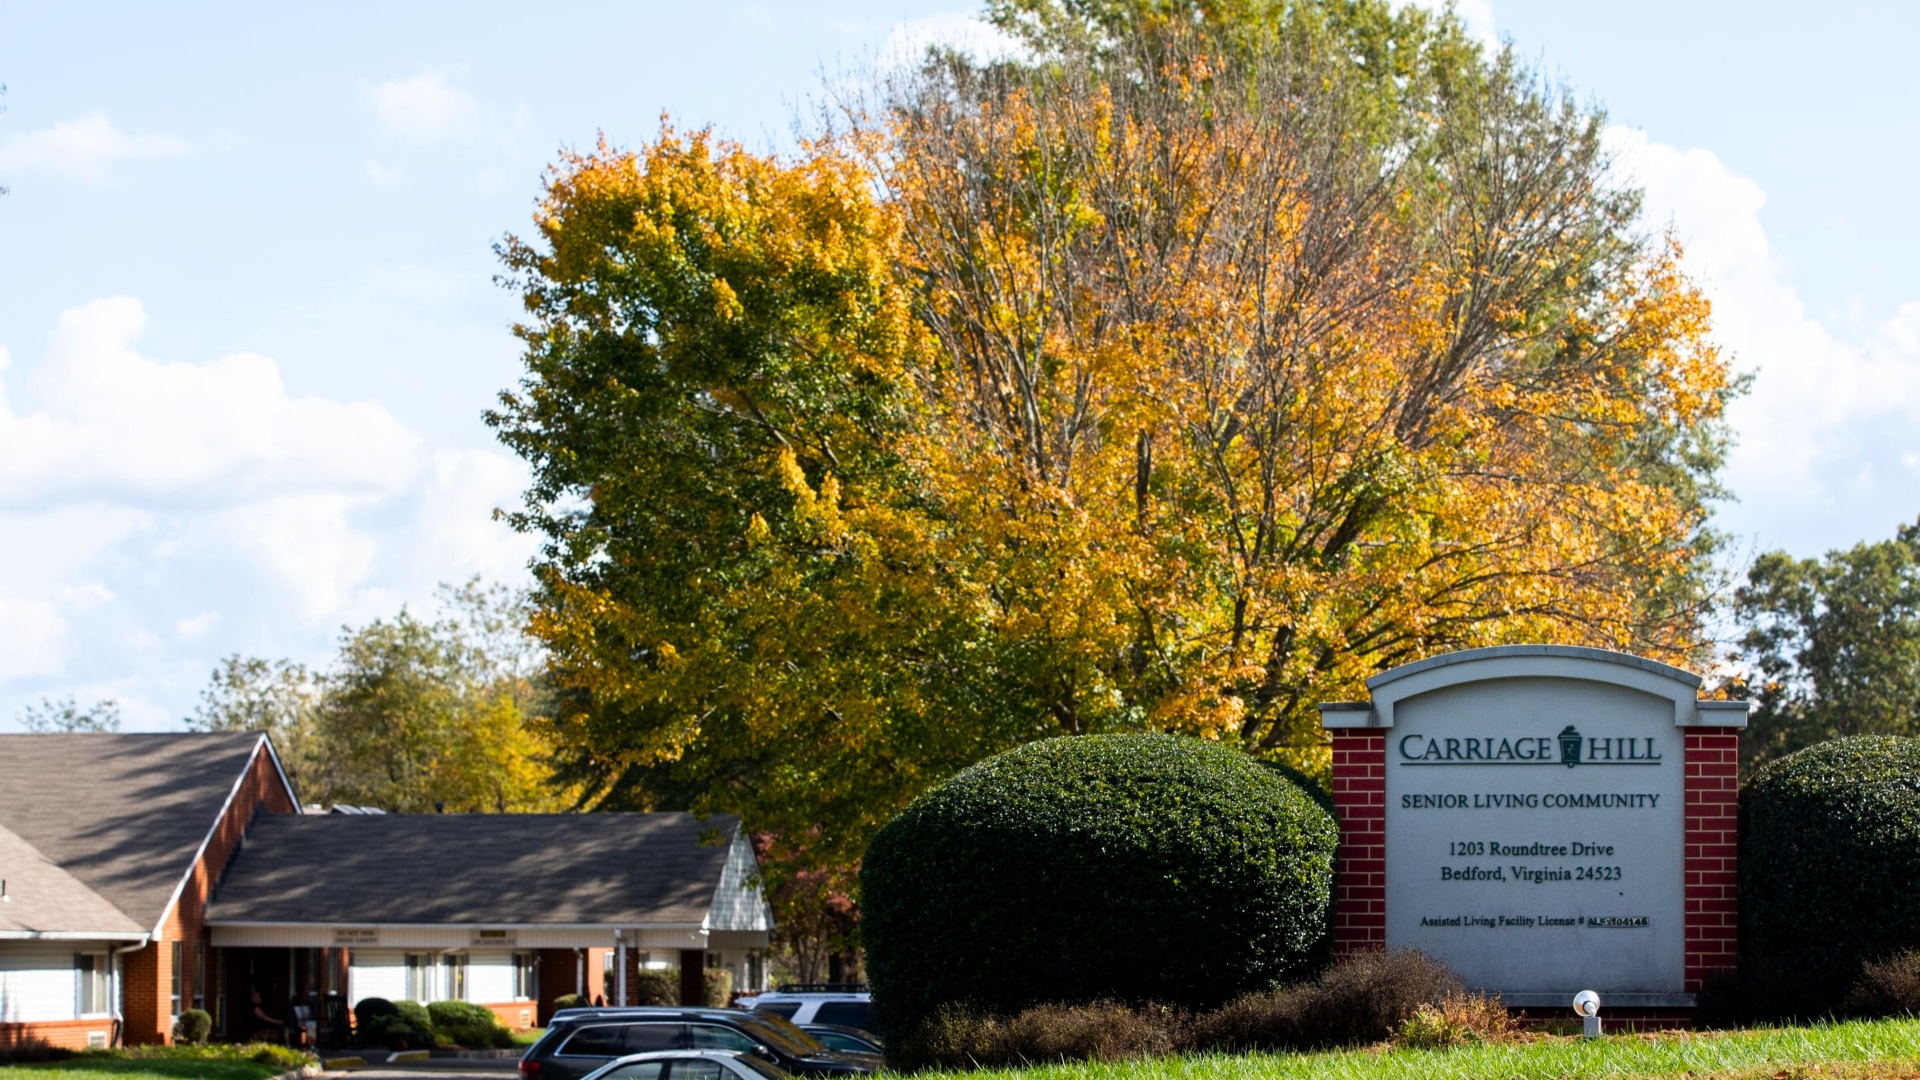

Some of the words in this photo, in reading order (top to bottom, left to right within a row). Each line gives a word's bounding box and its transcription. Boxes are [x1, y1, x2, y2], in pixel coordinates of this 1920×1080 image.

[1400, 734, 1551, 760] CARRIAGE
[1588, 737, 1662, 760] HILL
[1402, 794, 1469, 809] SENIOR
[1474, 794, 1538, 809] LIVING
[1542, 794, 1660, 809] COMMUNITY
[1450, 842, 1485, 856] 1203
[1490, 842, 1567, 856] Roundtree
[1572, 842, 1614, 856] Drive
[1441, 866, 1507, 883] Bedford,
[1511, 866, 1572, 884] Virginia
[1576, 866, 1622, 881] 24523
[1420, 916, 1461, 927] Assisted
[1464, 916, 1496, 928] Living
[1499, 916, 1535, 928] Facility
[1538, 916, 1575, 926] License
[1578, 916, 1585, 925] #
